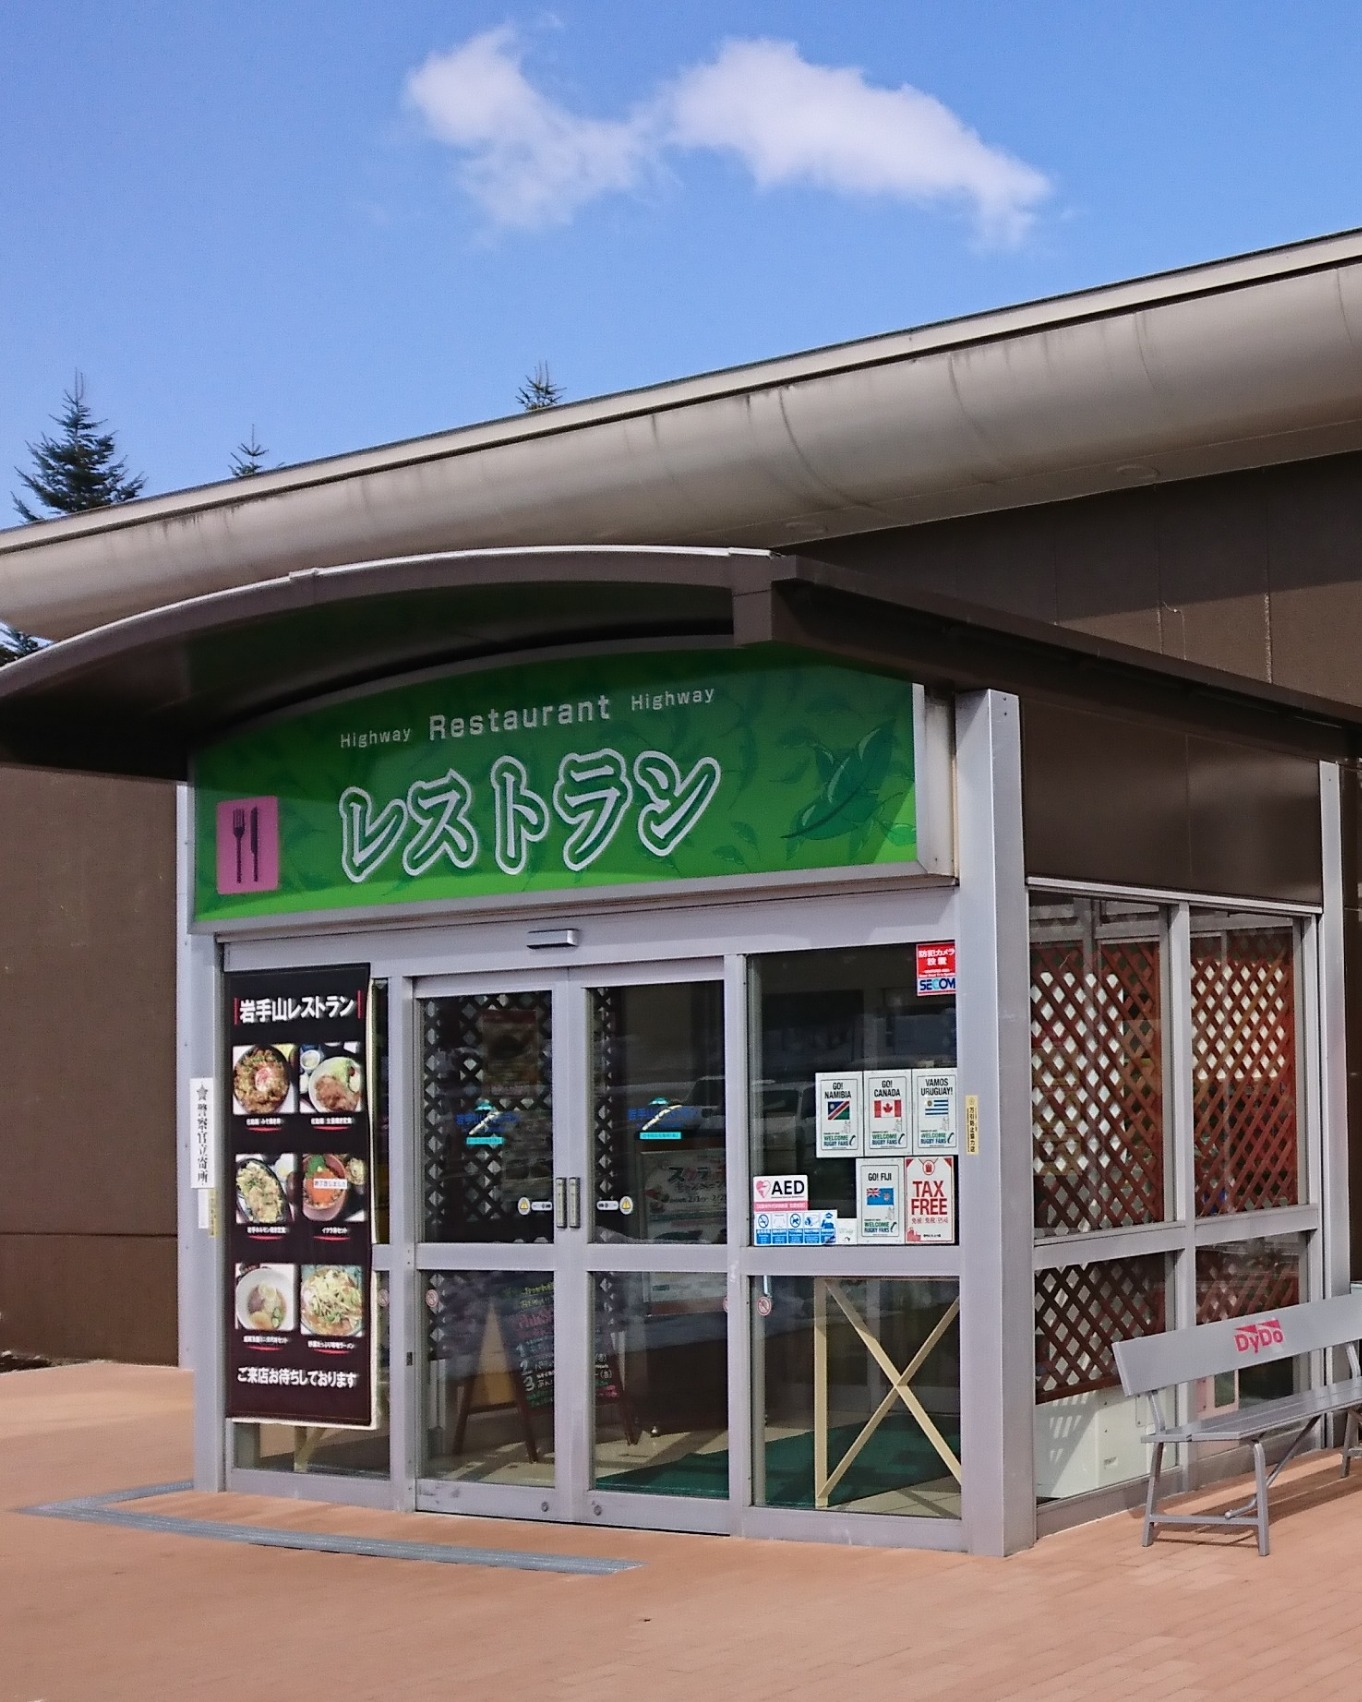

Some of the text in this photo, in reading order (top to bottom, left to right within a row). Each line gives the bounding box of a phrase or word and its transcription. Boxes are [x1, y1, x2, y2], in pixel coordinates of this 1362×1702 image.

[339, 686, 716, 750] Highway Restaurant Highway
[338, 747, 722, 884] レストラン
[920, 978, 956, 991] SECOM
[239, 996, 355, 1024] 岩手山レストラン
[832, 1082, 844, 1090] GO!
[881, 1080, 893, 1088] GO!
[925, 1078, 949, 1087] VAMOS
[824, 1090, 852, 1099] NAMIBIA
[874, 1088, 901, 1098] CANADA
[920, 1087, 954, 1096] URUGUAY!
[868, 1172, 892, 1181] GO! FIJI
[771, 1180, 805, 1195] AED
[913, 1181, 944, 1197] TAX
[911, 1198, 947, 1215] FREE
[1234, 1328, 1284, 1354] DyDo
[237, 1366, 358, 1389] ご来店お待ちしております
